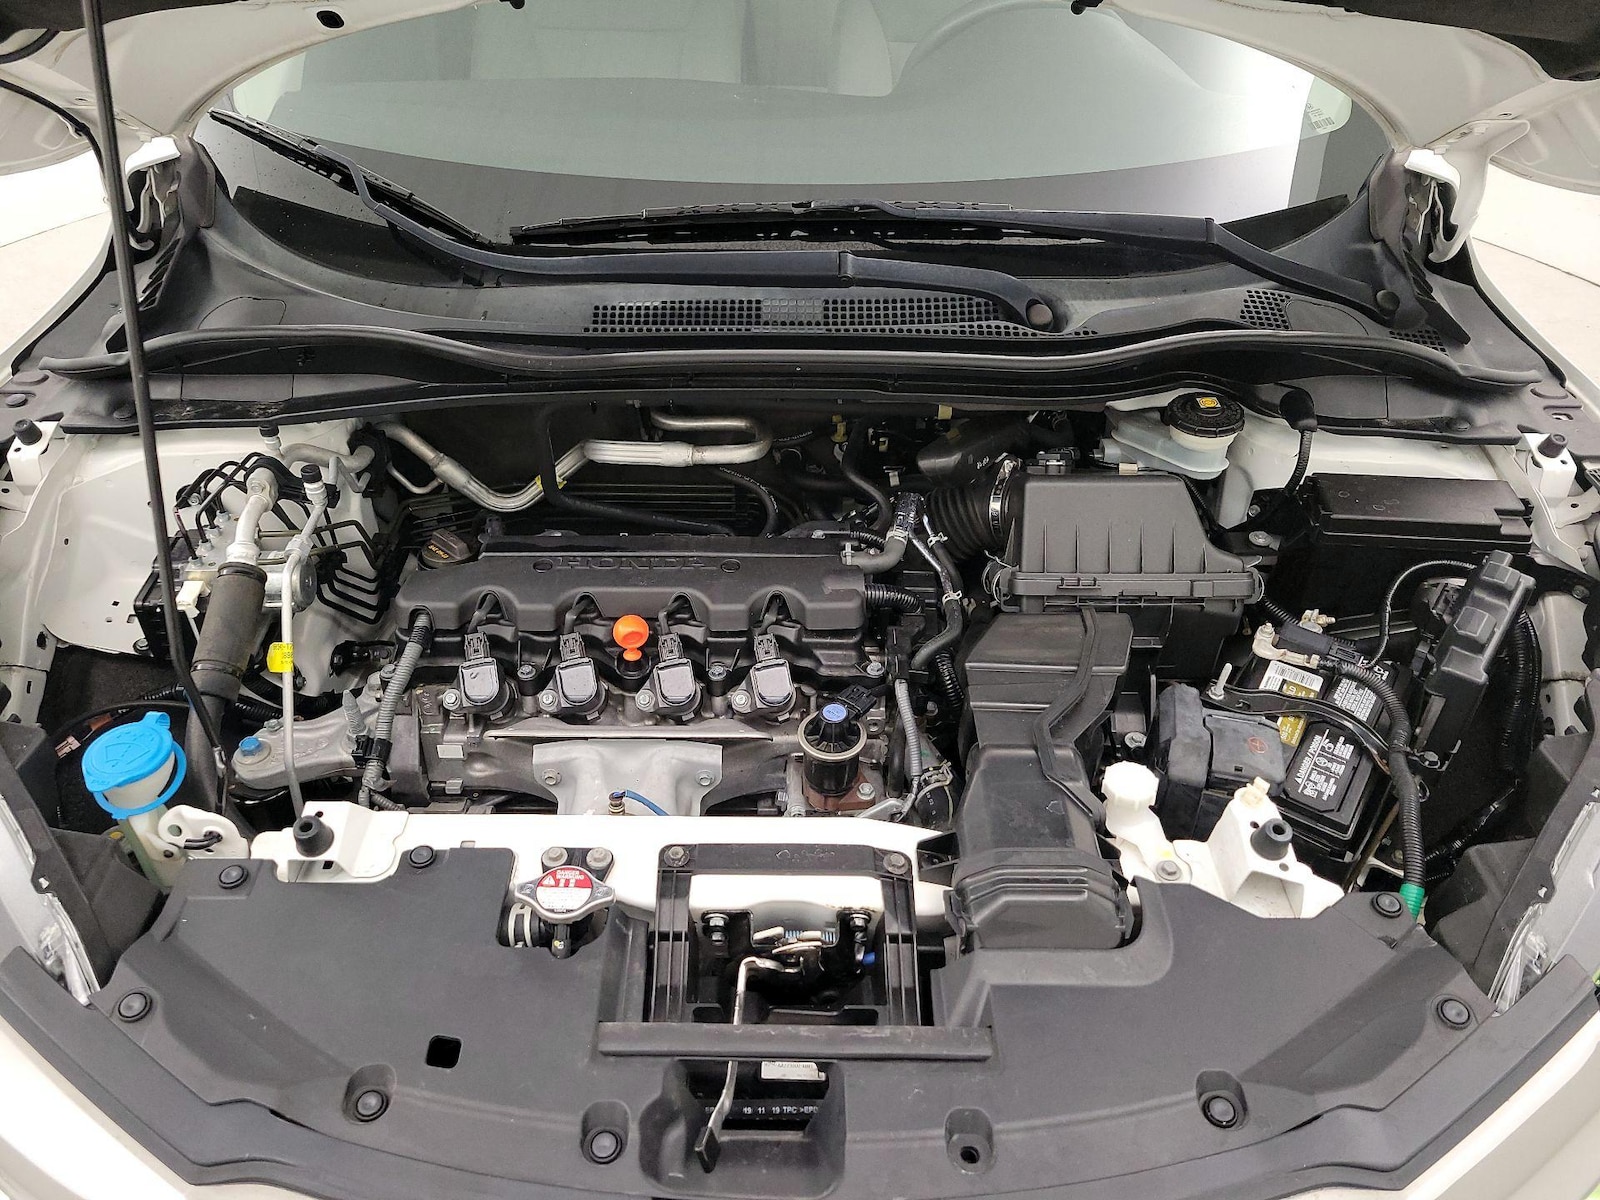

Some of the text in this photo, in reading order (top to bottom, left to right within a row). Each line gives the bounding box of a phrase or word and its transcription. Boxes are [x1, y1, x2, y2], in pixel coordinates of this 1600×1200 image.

[556, 557, 718, 570] HONDA
[1297, 756, 1312, 779] DANGER
[1308, 734, 1323, 754] POISON
[556, 868, 580, 876] DANGER
[757, 1106, 766, 1115] 11
[771, 1106, 781, 1115] 19
[782, 1106, 798, 1115] TPC
